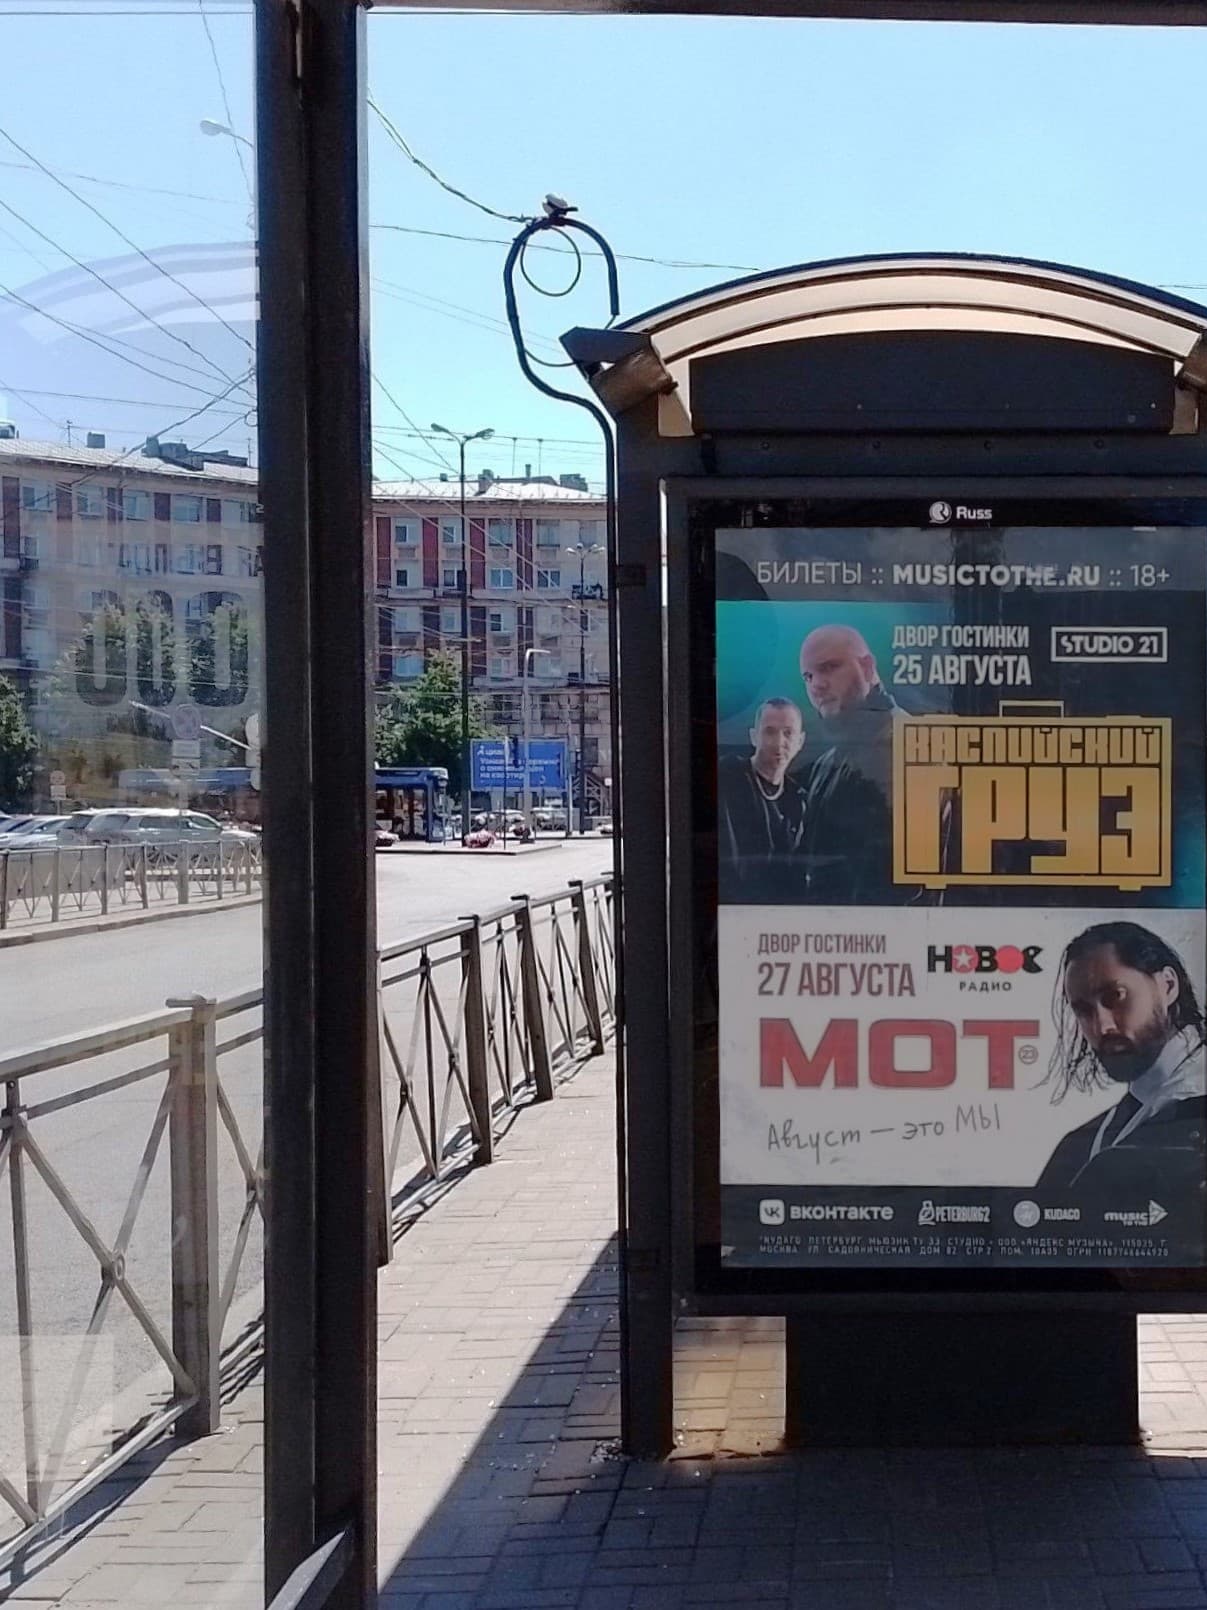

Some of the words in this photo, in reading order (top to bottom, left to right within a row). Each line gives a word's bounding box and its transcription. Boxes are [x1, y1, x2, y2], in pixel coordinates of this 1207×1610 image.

[956, 506, 992, 519] Russ
[757, 562, 862, 584] БИЛЕТЫ
[893, 564, 1100, 586] MUSICTOTHE.RU
[1130, 564, 1170, 586] 18+
[892, 626, 938, 649] ДВОР
[942, 626, 1029, 648] ГОСТИНКИ
[1061, 635, 1134, 653] STUDIO
[1139, 636, 1159, 653] 21
[893, 655, 922, 684] 25
[928, 655, 1032, 685] АВГУСТА
[905, 727, 1161, 764] КАСПИЙСКИЙ
[906, 766, 1161, 874] ГРУЗ
[758, 934, 800, 955] ДВОР
[804, 934, 887, 954] ГОСТИНКИ
[758, 963, 791, 996] 27
[797, 963, 916, 997] АВГУСТА
[959, 981, 1013, 992] РАДИО
[759, 1018, 1040, 1090] МОТ
[768, 1119, 861, 1165] Август
[902, 1121, 944, 1140] это
